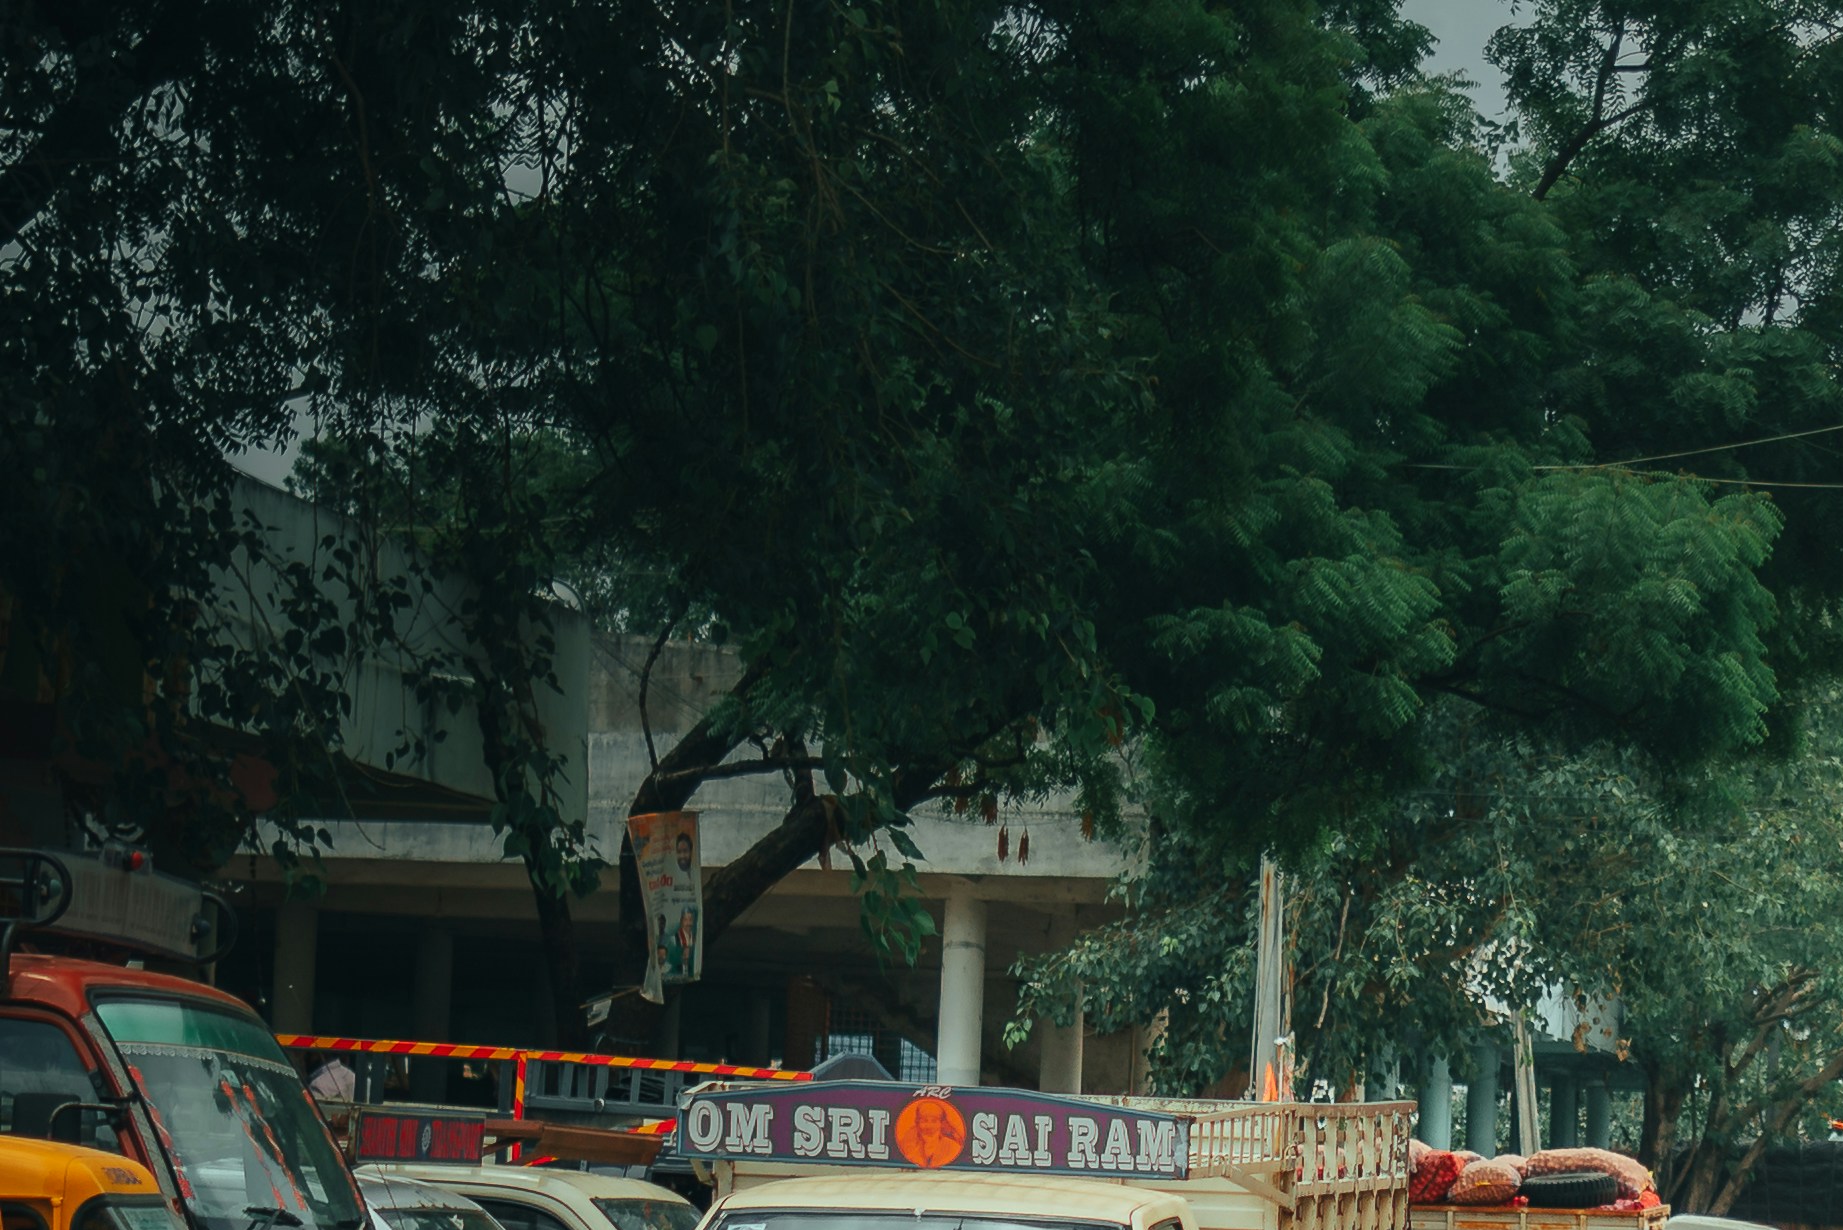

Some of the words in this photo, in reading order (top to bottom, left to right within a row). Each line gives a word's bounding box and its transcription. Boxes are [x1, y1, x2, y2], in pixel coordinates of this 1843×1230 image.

[688, 1100, 774, 1154] OM
[793, 1105, 890, 1160] SRI
[972, 1112, 1053, 1167] SAI
[1067, 1116, 1176, 1172] RAM
